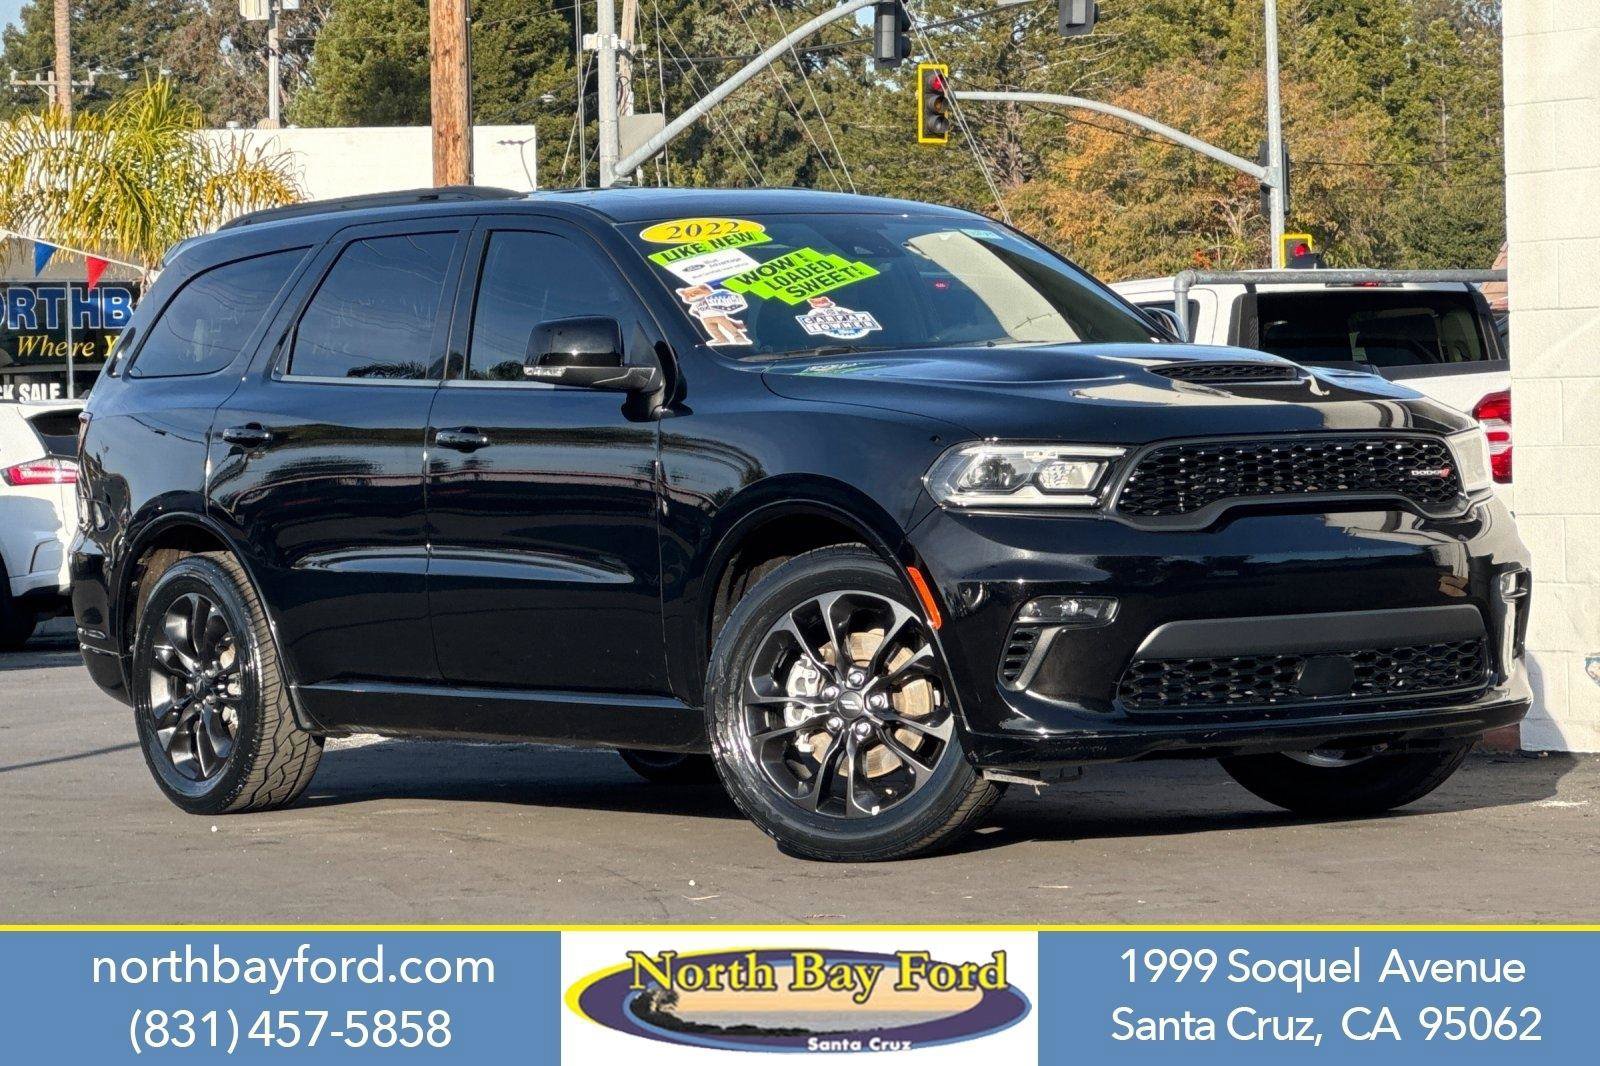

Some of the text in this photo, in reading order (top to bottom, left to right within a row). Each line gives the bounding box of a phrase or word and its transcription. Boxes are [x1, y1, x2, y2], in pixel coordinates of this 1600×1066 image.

[666, 221, 741, 241] 2022
[661, 231, 754, 262] LIKE NEW
[764, 259, 835, 291] LOADED
[785, 264, 863, 298] SWEET!
[17, 334, 95, 357] Where
[19, 382, 60, 403] SALE
